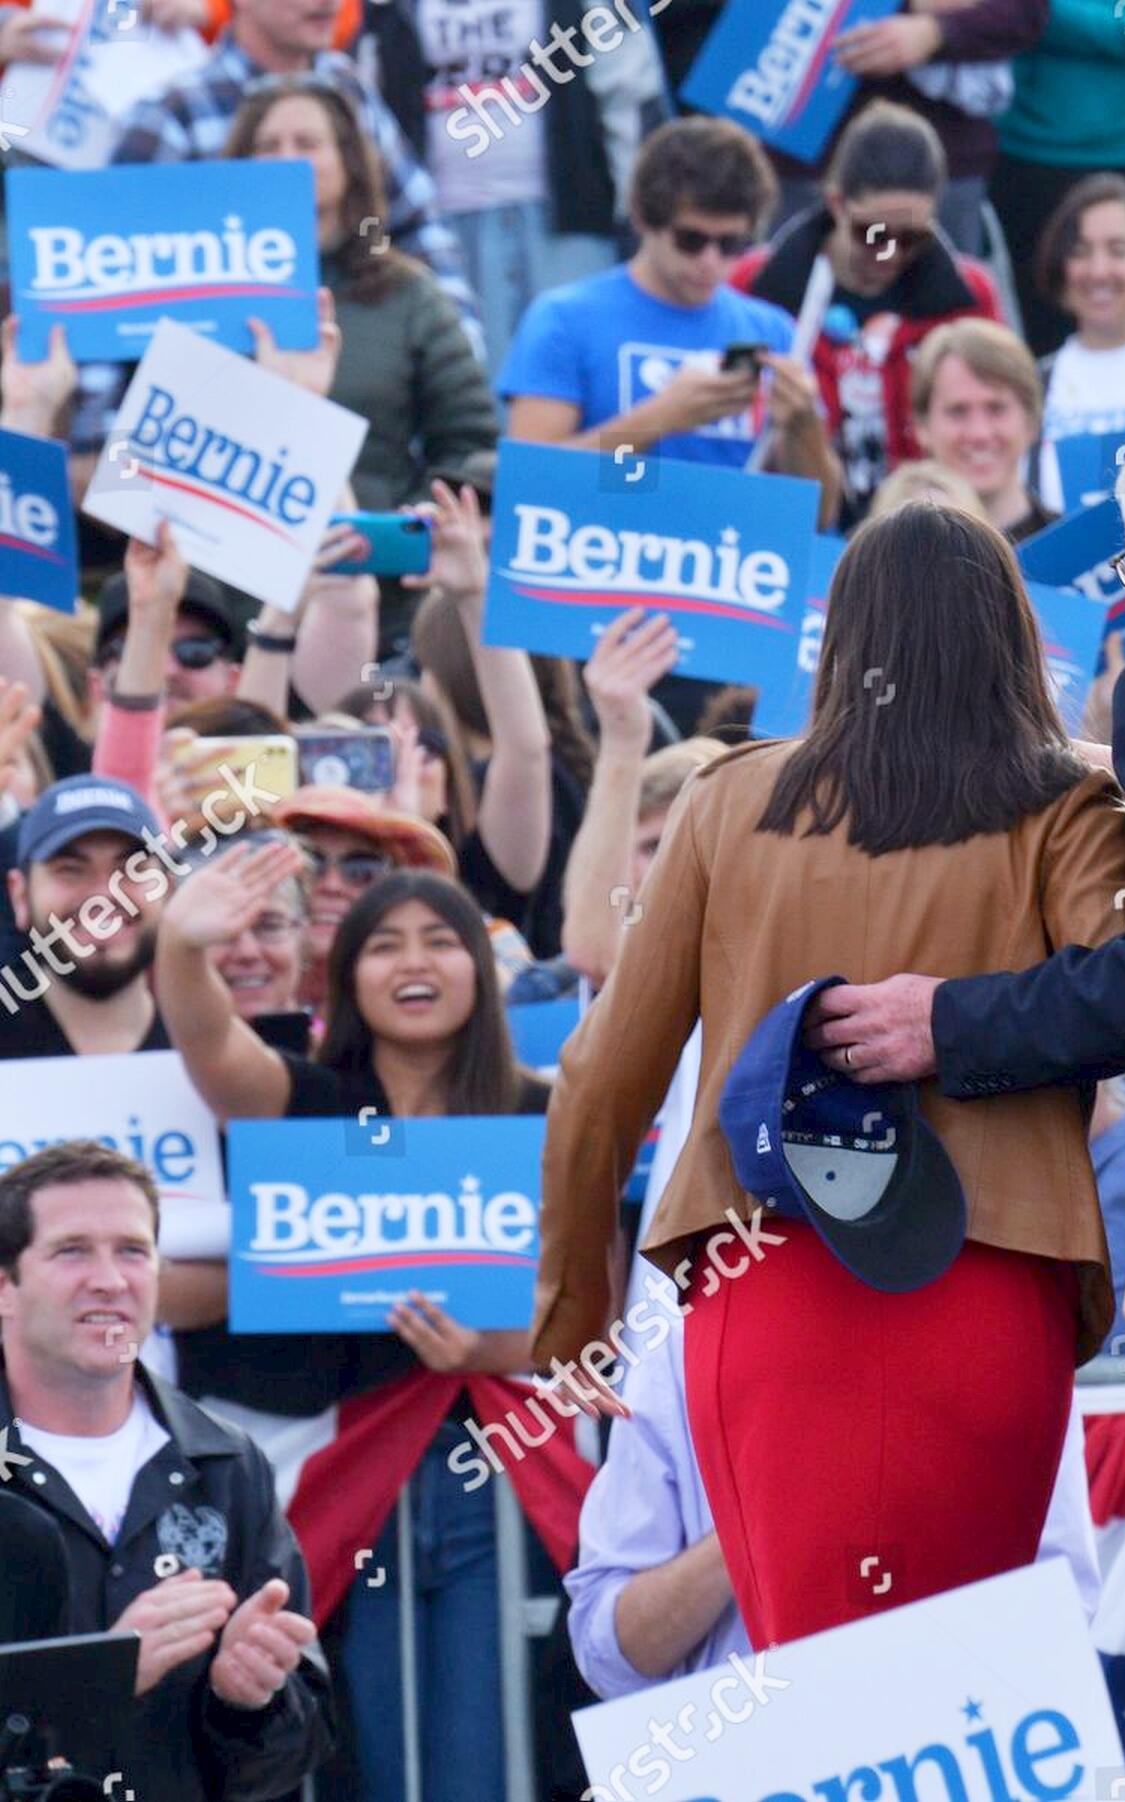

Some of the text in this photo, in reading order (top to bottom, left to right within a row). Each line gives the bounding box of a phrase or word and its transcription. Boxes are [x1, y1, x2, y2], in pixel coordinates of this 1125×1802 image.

[28, 213, 296, 290] Bernie
[128, 385, 317, 526] Bernie
[509, 503, 790, 609] Bernie
[249, 1174, 535, 1253] Bernie
